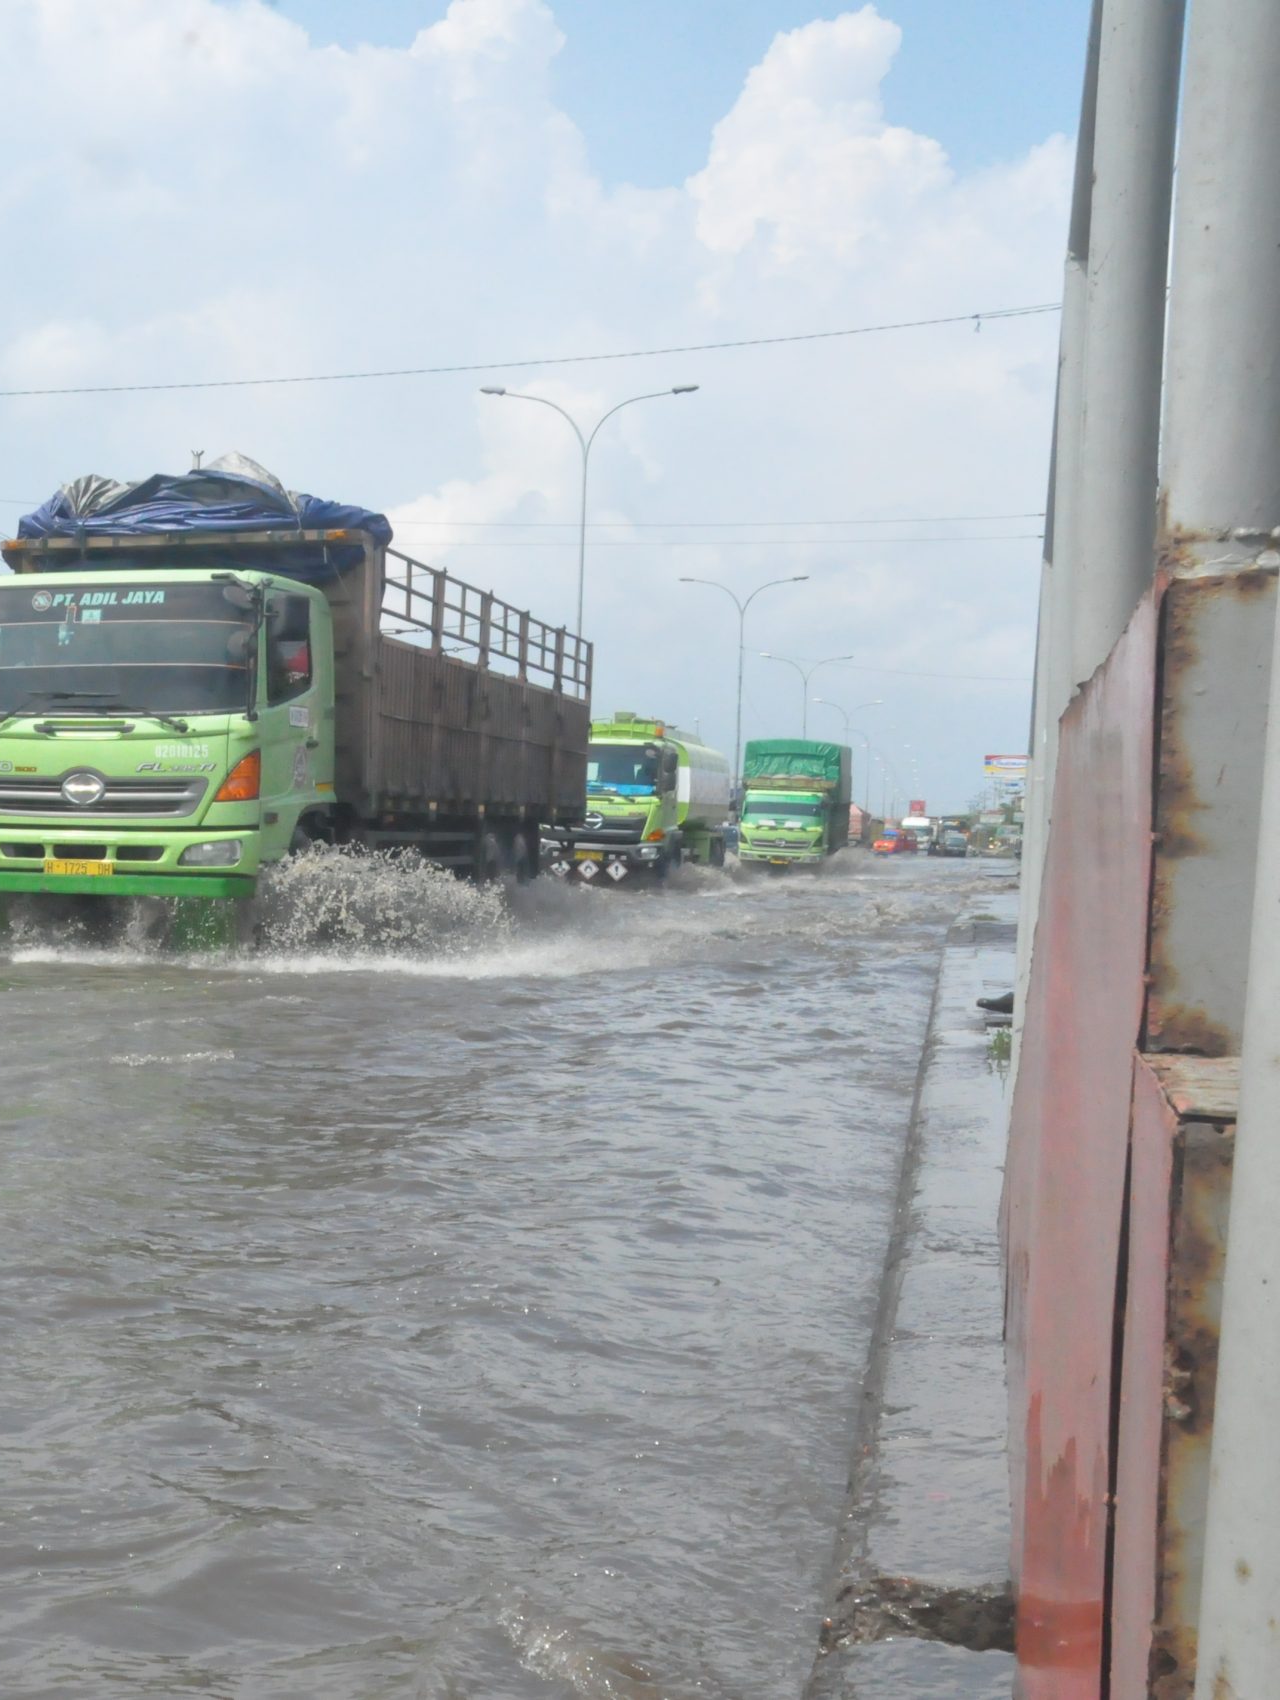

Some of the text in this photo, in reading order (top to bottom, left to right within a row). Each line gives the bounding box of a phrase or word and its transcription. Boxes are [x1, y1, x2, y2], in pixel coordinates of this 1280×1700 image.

[52, 591, 165, 607] PT. ADIL JAYA
[46, 861, 54, 874] H
[64, 861, 88, 876] 1725
